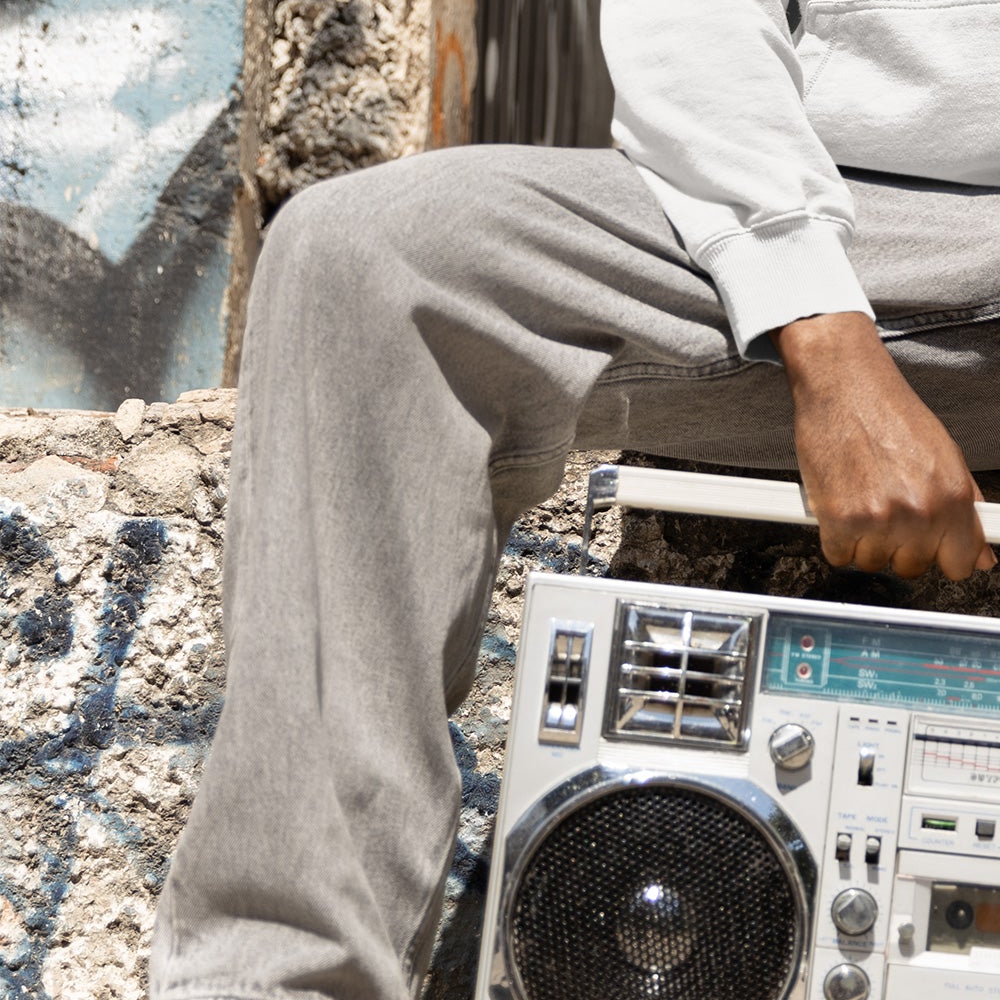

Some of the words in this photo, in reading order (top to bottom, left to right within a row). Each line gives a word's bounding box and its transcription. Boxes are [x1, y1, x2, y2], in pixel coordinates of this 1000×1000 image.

[860, 650, 880, 659] AM
[837, 812, 856, 821] TAPE
[866, 815, 888, 823] MODE
[921, 837, 954, 846] COUNTER
